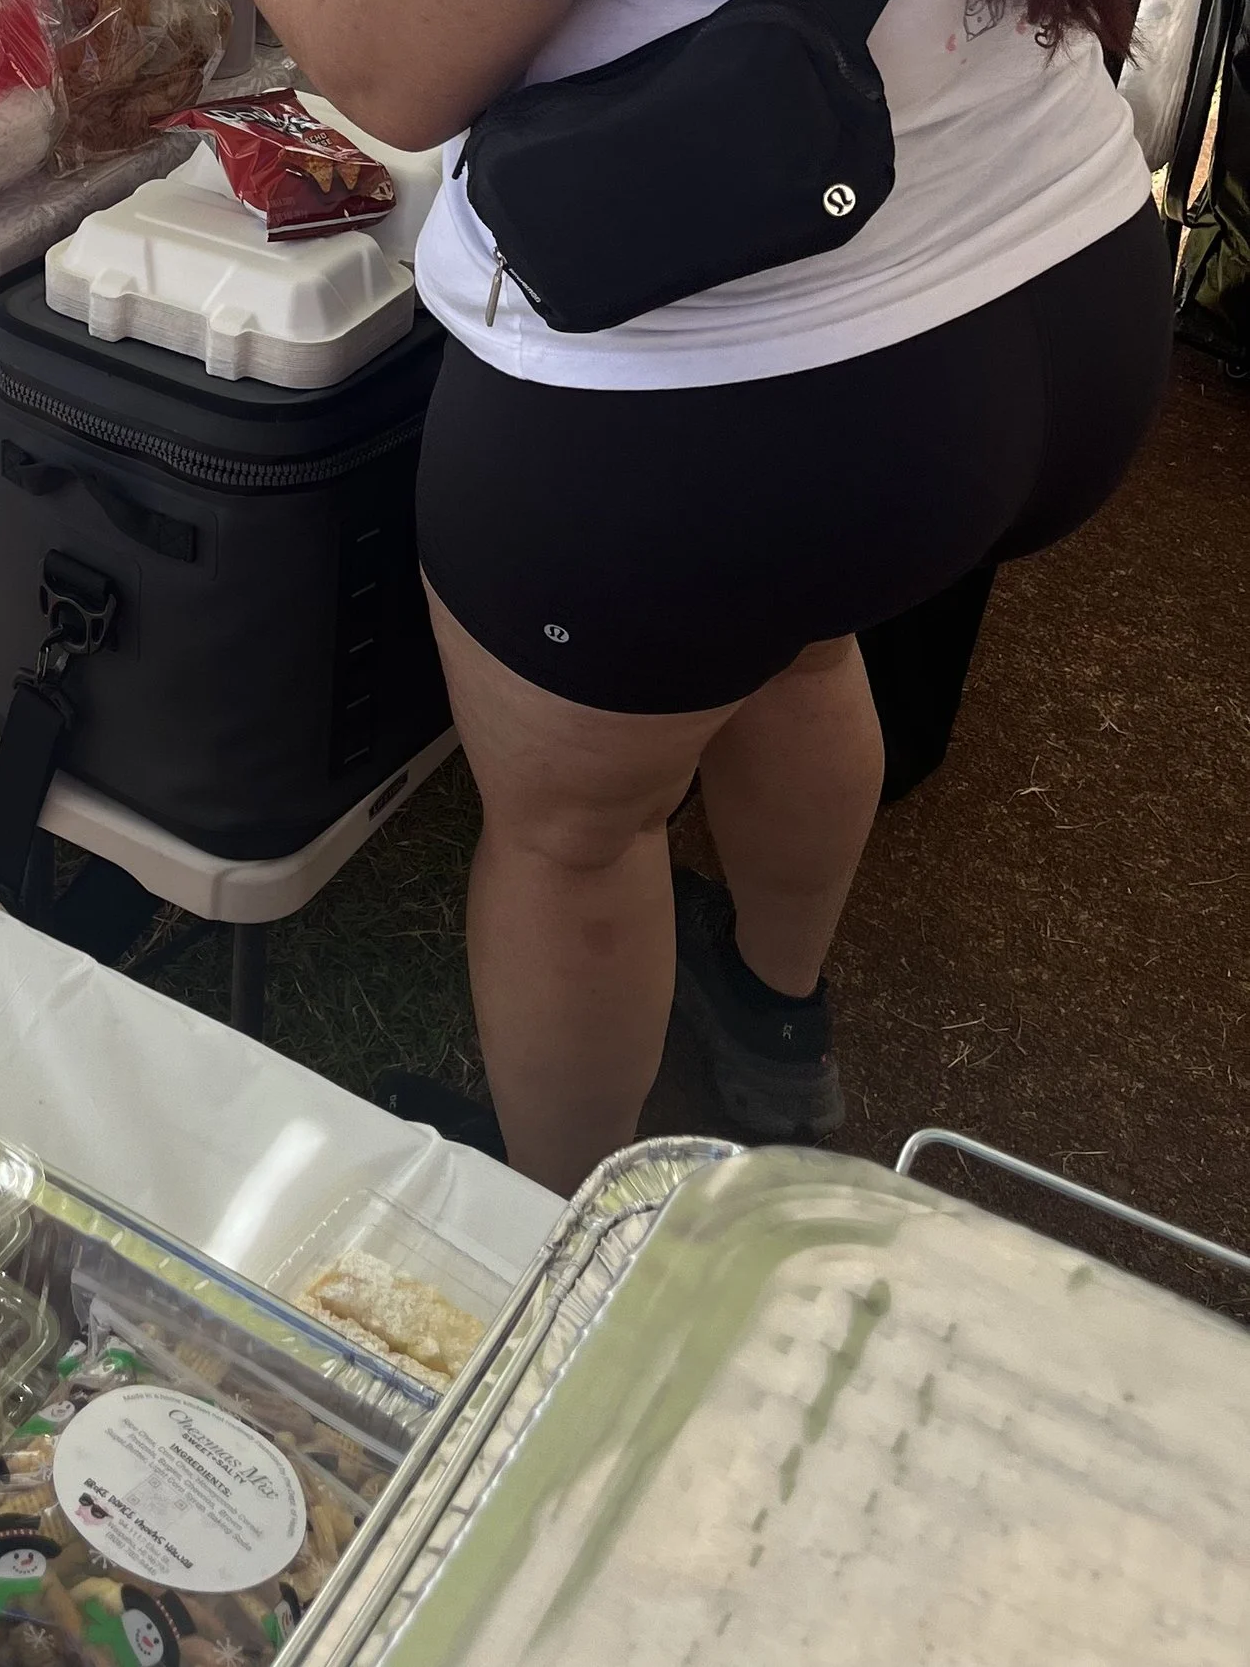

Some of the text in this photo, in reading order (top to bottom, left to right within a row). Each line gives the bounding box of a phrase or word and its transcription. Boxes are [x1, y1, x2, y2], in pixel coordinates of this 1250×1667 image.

[168, 1409, 279, 1499] Chexmas Mix
[169, 1443, 230, 1498] INGREDIENTS:
[167, 1477, 186, 1493] Corn
[218, 1509, 243, 1531] Brown
